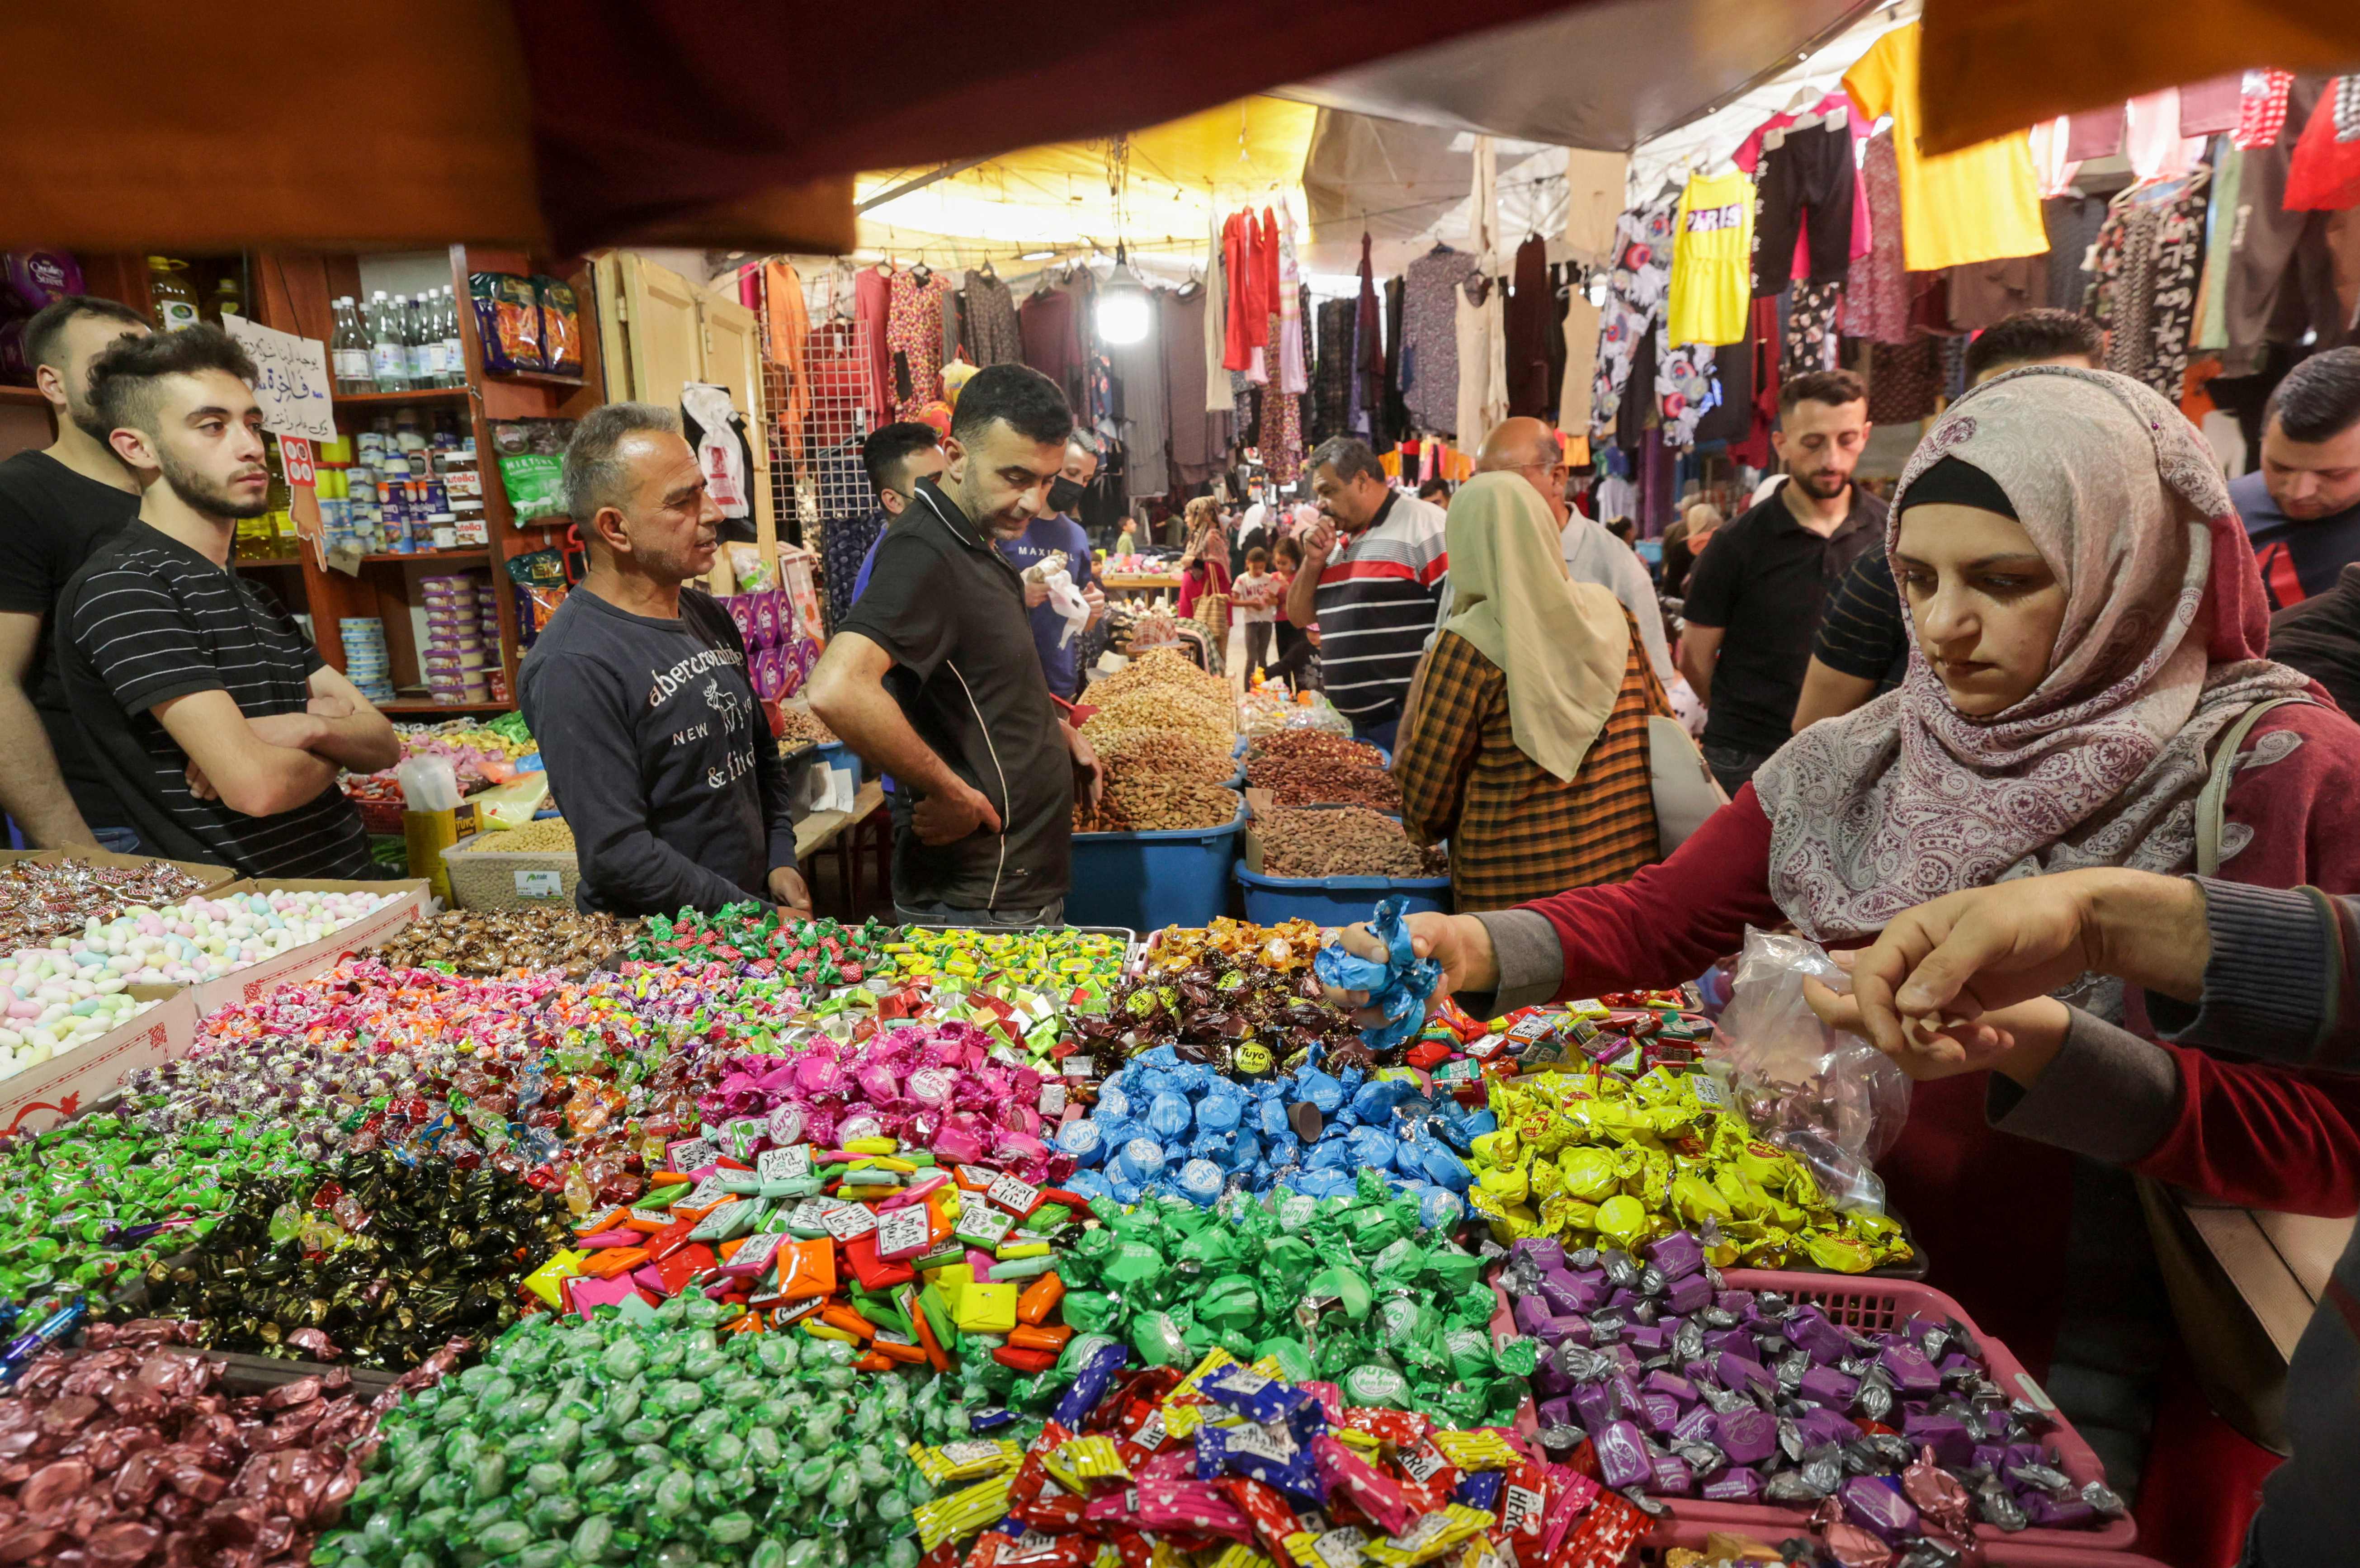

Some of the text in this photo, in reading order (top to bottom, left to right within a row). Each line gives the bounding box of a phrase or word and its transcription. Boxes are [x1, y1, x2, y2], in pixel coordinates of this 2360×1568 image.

[1687, 204, 1742, 231] PARIS
[457, 523, 482, 532] utella
[1019, 546, 1074, 562] MAXIL
[650, 640, 744, 707] abercrombie
[673, 723, 708, 746] NEW
[708, 767, 727, 789] &
[95, 872, 122, 885] Twix
[127, 888, 154, 897] Twix
[86, 904, 114, 918] Twix
[1242, 1048, 1265, 1060] Tuyo
[214, 1118, 234, 1127] Fruit
[1196, 1168, 1221, 1185] Tuyo
[999, 1190, 1023, 1206] my
[1005, 1182, 1034, 1204] Love
[99, 1219, 124, 1227] Fruit
[826, 1209, 853, 1231] Love
[852, 1207, 873, 1223] my
[880, 1216, 897, 1244] you
[901, 1207, 923, 1245] I miss
[1144, 1427, 1166, 1445] HE
